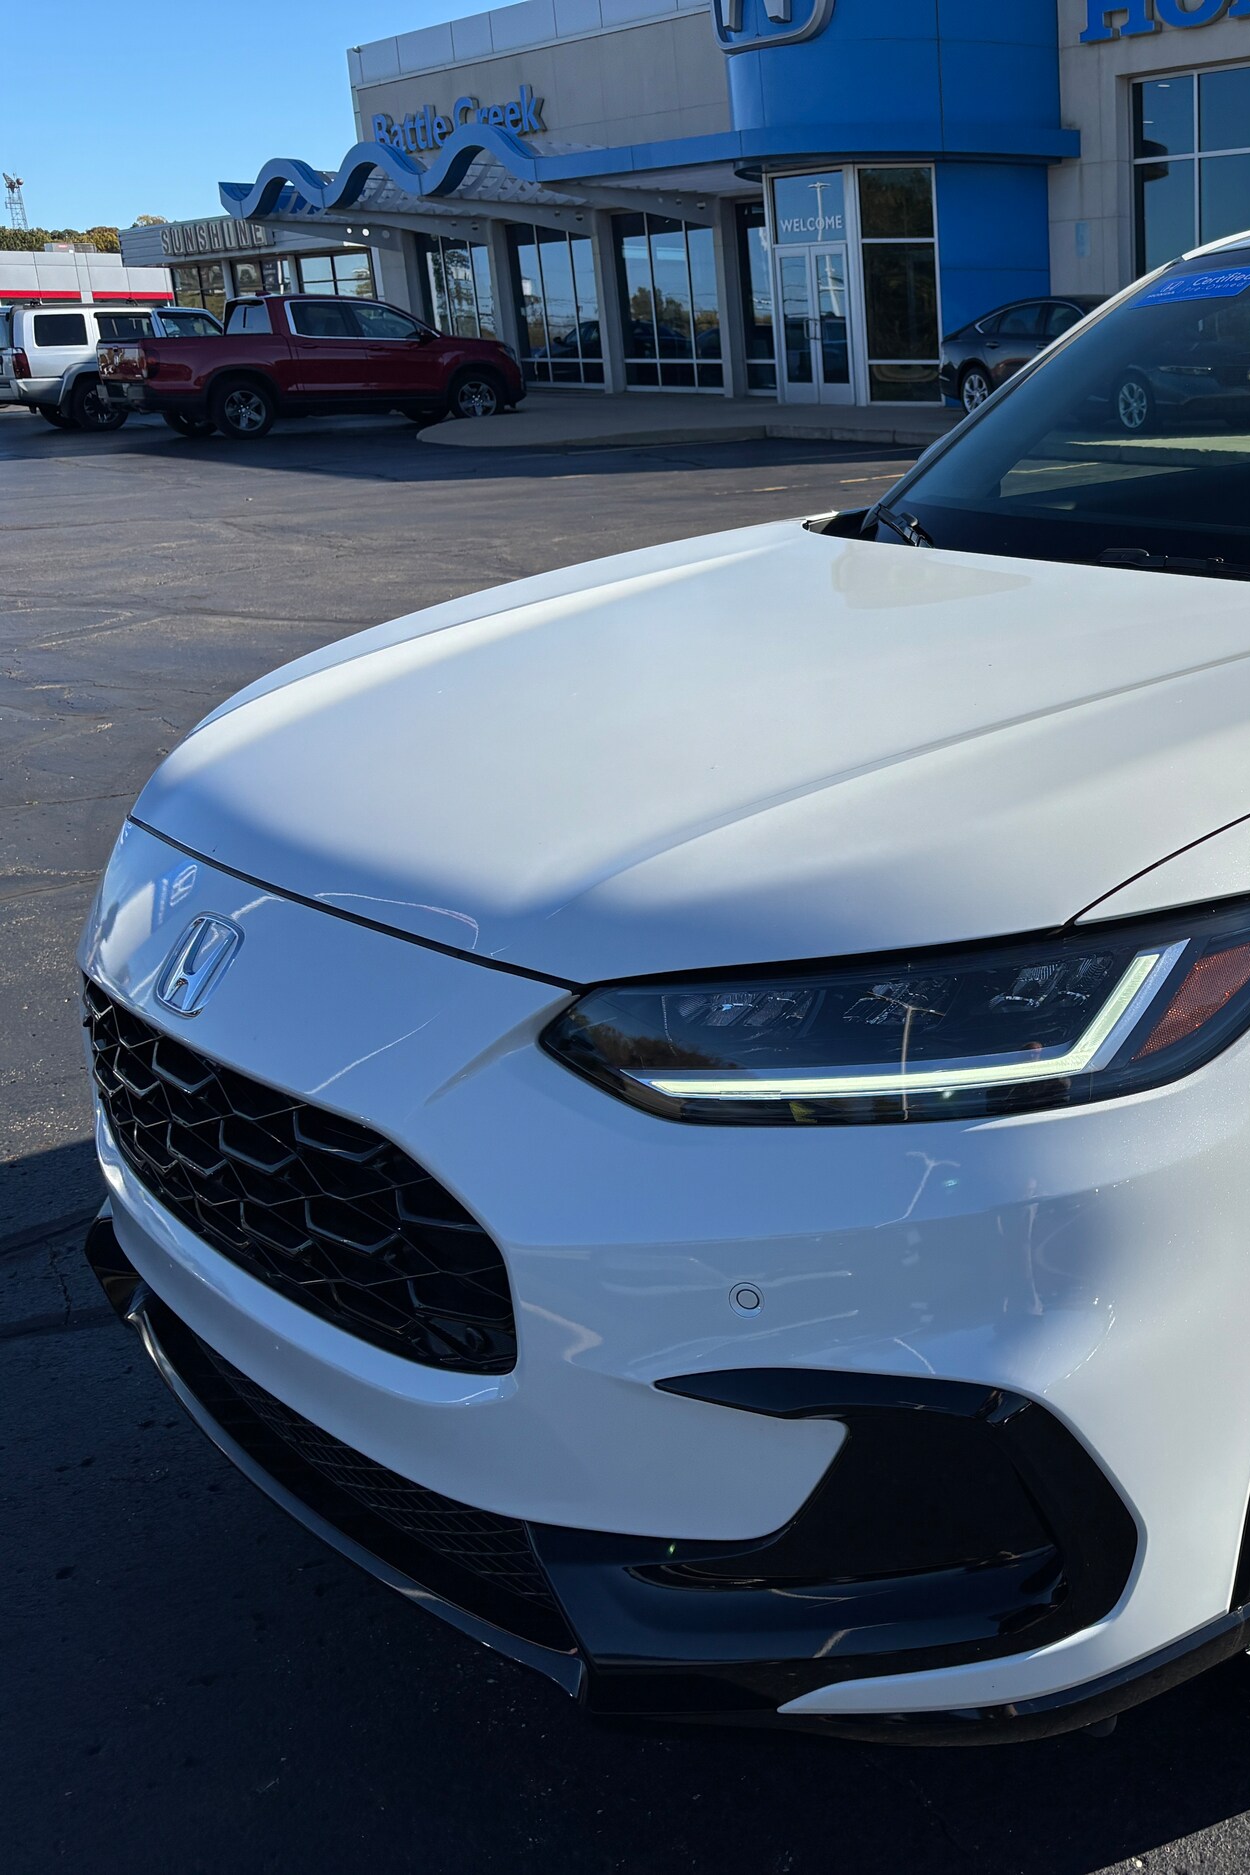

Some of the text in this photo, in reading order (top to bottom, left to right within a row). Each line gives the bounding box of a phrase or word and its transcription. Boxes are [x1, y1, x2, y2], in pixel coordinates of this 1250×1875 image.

[372, 84, 547, 152] Battle Creek
[161, 219, 266, 254] SUNSHINE
[780, 215, 843, 232] WELCOME
[1183, 281, 1248, 294] Pre-Owned
